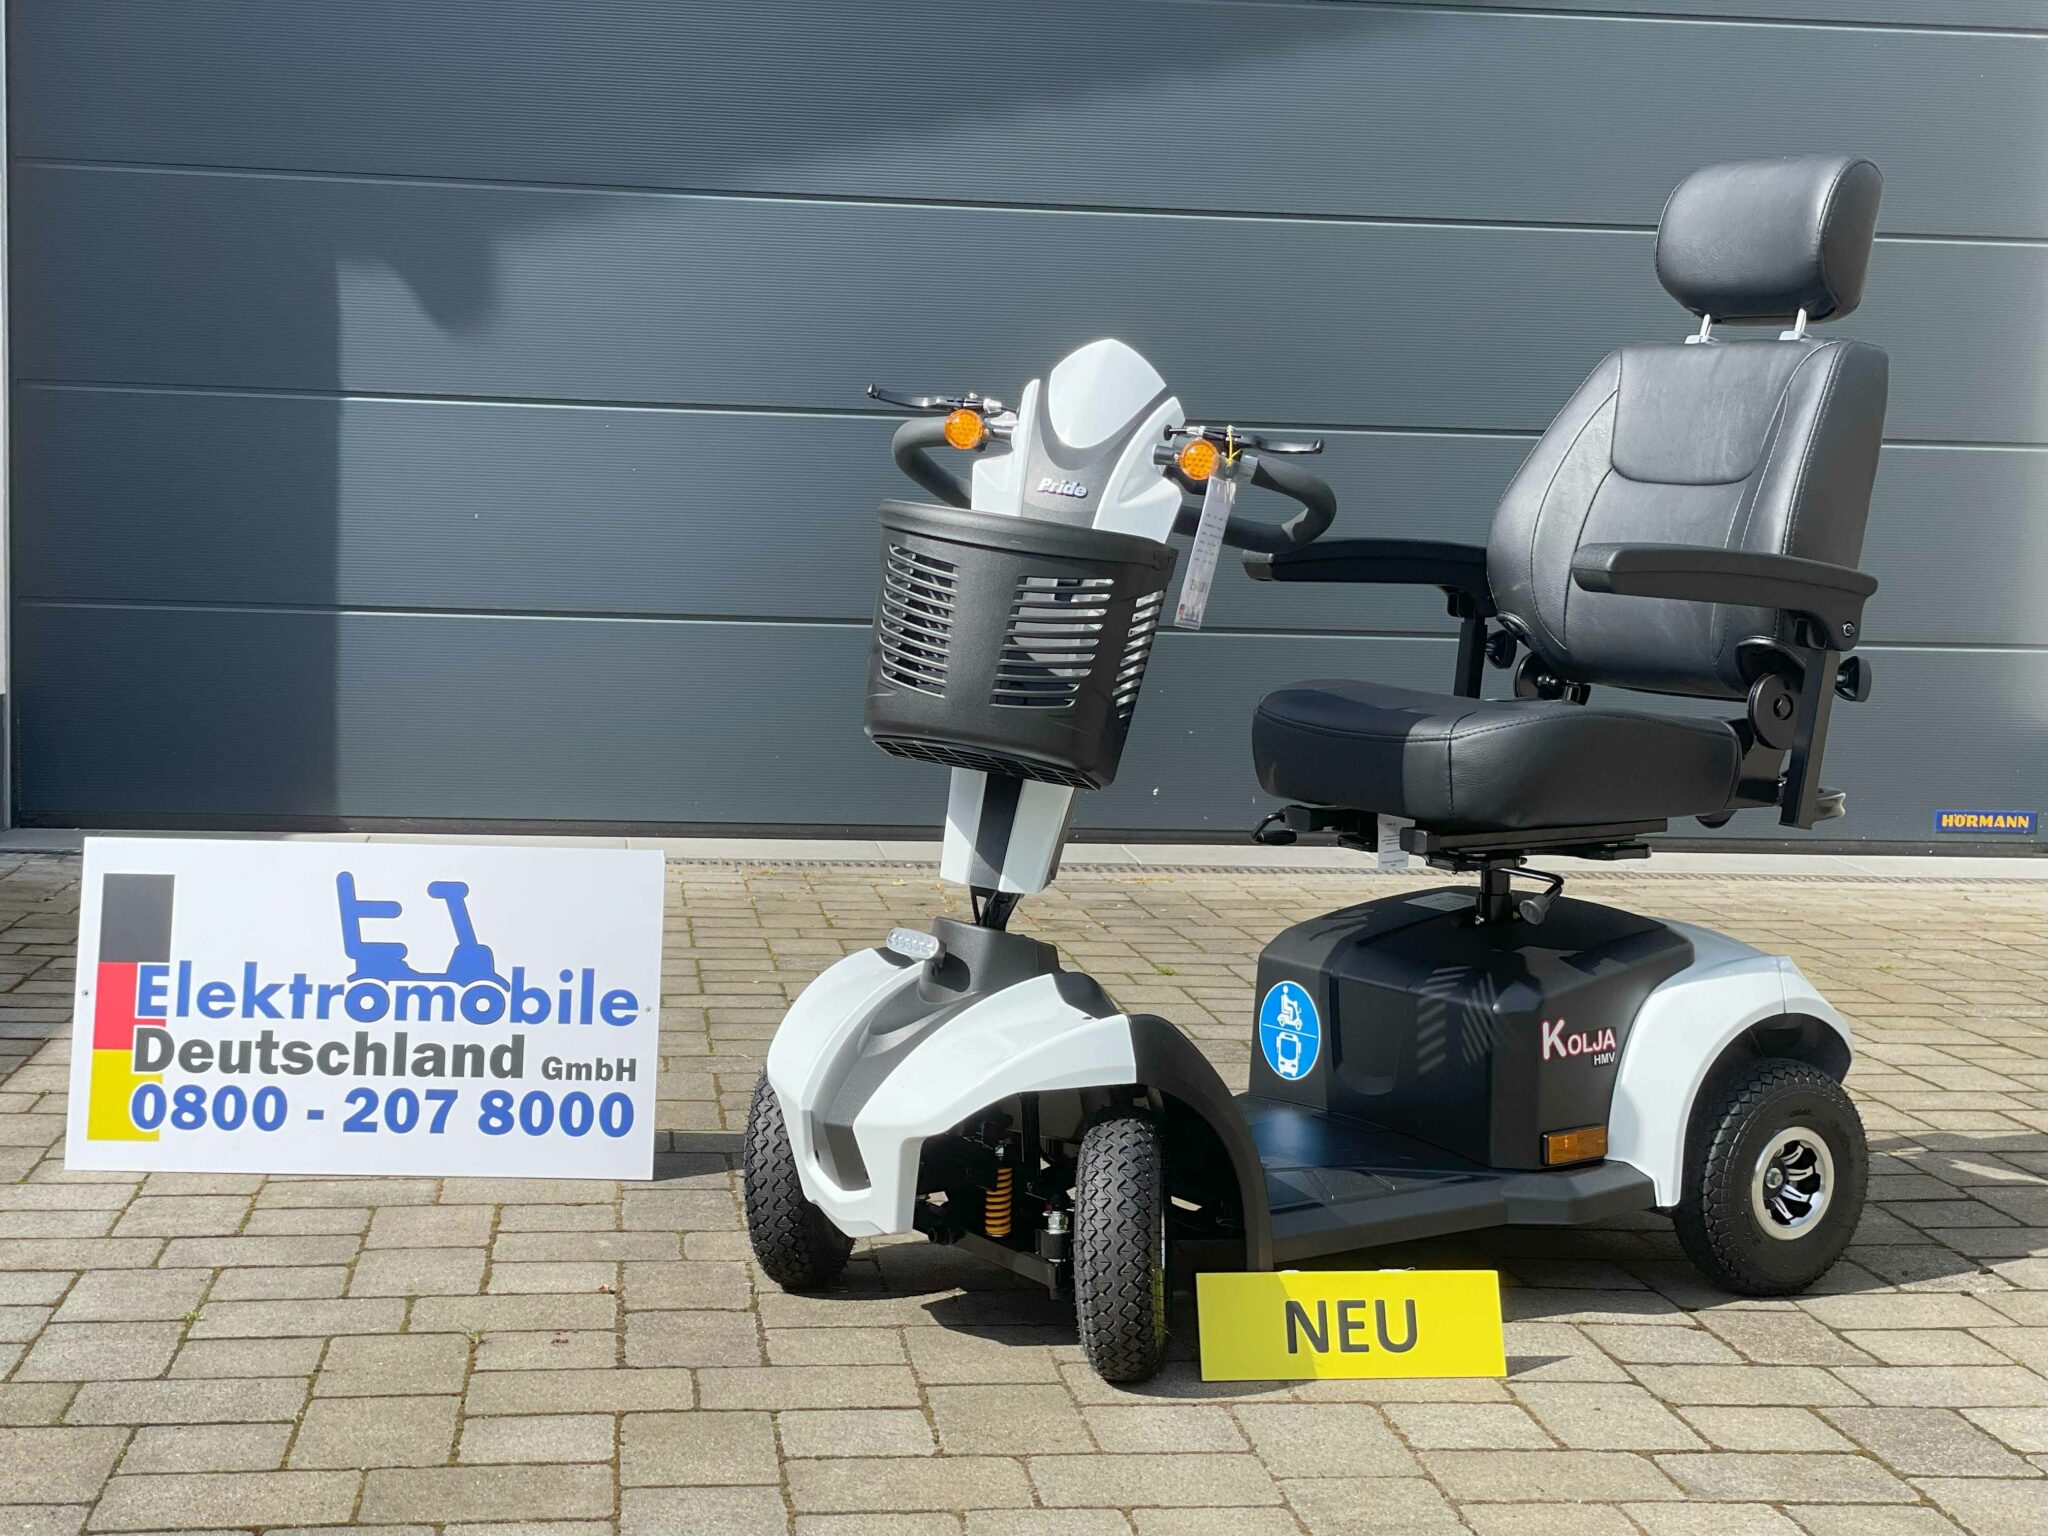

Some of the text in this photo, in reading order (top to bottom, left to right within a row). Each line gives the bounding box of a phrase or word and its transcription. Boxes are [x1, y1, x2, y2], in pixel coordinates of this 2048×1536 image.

[1037, 477, 1088, 499] Pride
[1941, 813, 2029, 828] HÖRMANN
[137, 961, 639, 1026] Elektromobile
[133, 1027, 637, 1082] Deutschland GmbH
[1593, 1052, 1616, 1066] HMV
[130, 1083, 635, 1138] 0800 - 207 8000
[1285, 1299, 1418, 1354] NEU
